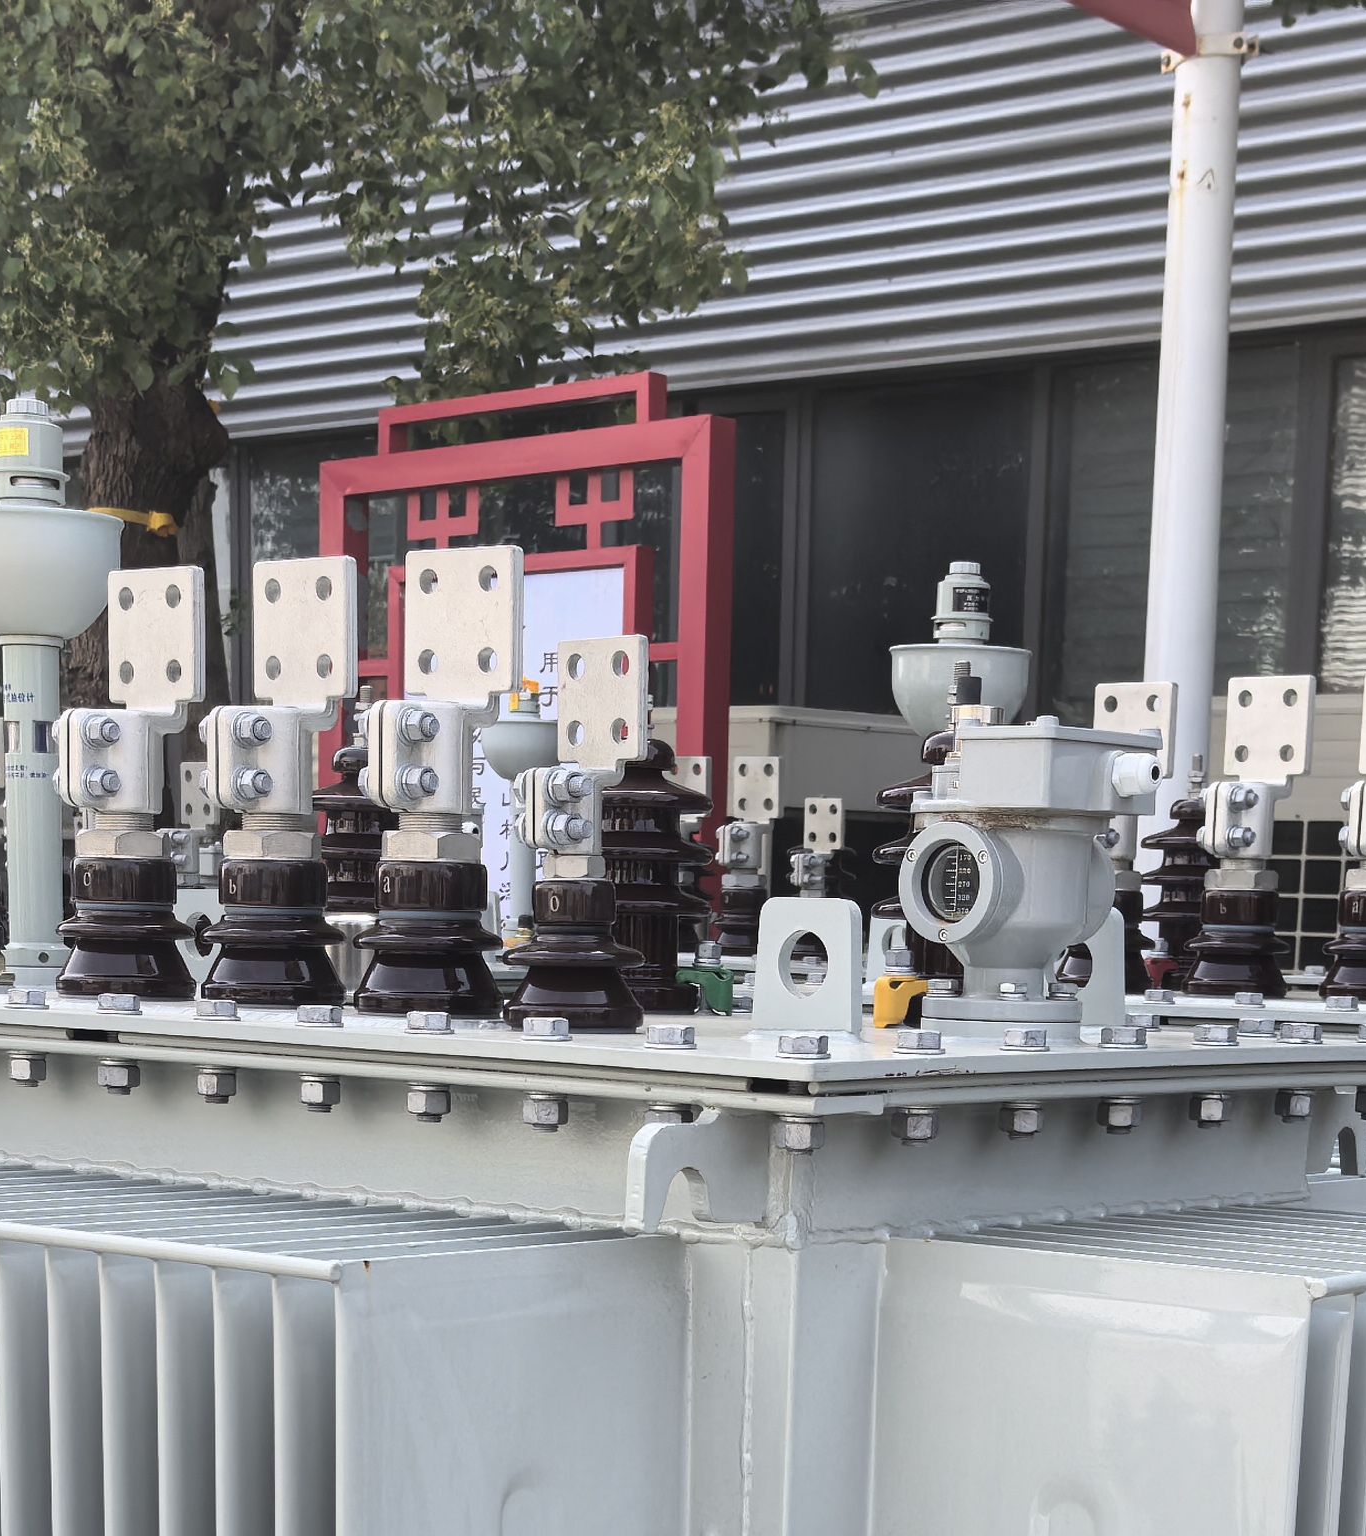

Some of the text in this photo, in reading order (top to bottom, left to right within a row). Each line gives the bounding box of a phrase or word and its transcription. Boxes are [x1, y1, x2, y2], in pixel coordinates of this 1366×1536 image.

[229, 878, 237, 895] b
[383, 876, 391, 894] a
[1219, 902, 1227, 914] b
[1351, 901, 1359, 914] a
